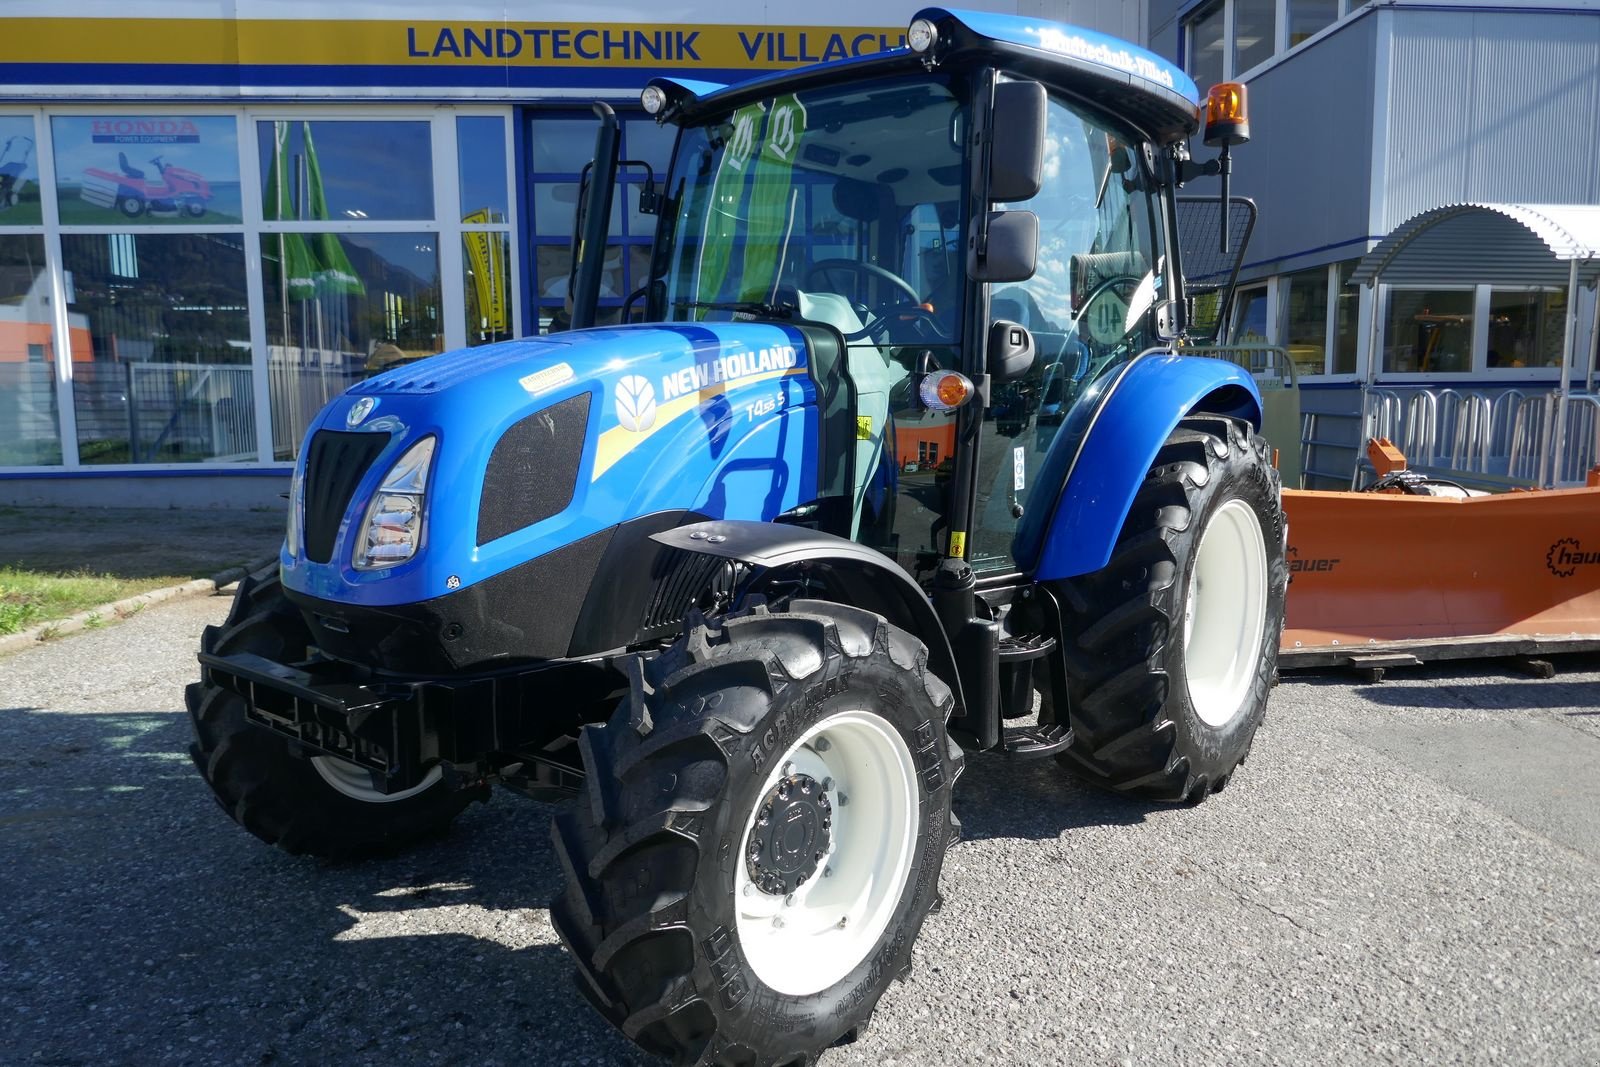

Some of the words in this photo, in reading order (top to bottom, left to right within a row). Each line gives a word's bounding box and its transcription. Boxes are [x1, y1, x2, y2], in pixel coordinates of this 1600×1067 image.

[407, 27, 702, 62] LANDTECHNIK
[92, 120, 199, 135] HONDA
[140, 136, 178, 144] EQUIPMENT
[661, 362, 710, 401] NEW
[712, 345, 797, 383] HOLLAND
[1558, 547, 1600, 565] hau
[1289, 558, 1341, 572] auer
